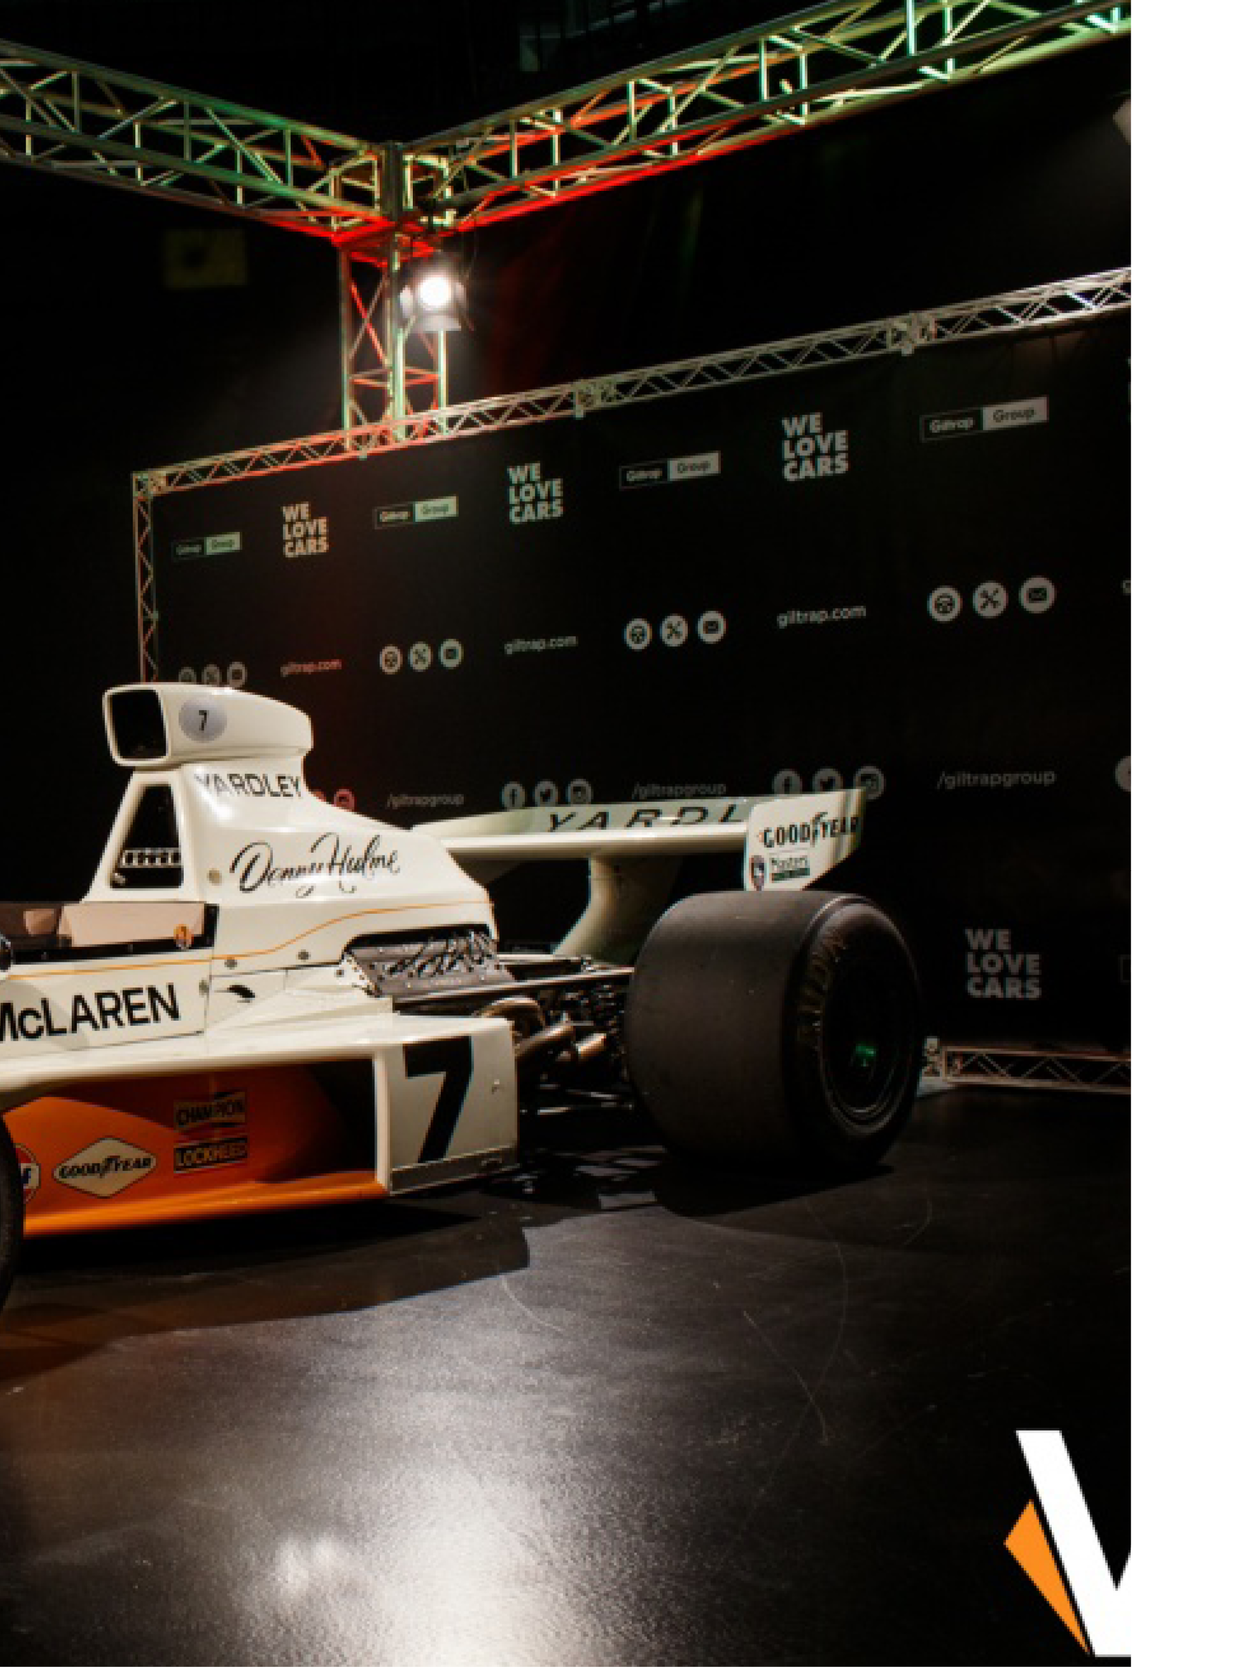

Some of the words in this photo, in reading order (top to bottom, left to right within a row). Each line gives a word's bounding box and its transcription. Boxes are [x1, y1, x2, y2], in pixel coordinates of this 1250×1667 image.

[781, 411, 823, 438] WE
[928, 417, 975, 434] Giltrap
[993, 408, 1035, 423] Group
[782, 430, 849, 460] LOVE
[507, 461, 541, 485] WE
[676, 459, 712, 474] Group
[783, 452, 850, 482] CARS
[508, 478, 564, 505] LOVE
[282, 503, 310, 522] WE
[510, 498, 565, 525] CARS
[282, 517, 328, 541] LOVE
[283, 536, 330, 558] CARS
[776, 605, 867, 630] giltrap.com
[504, 635, 579, 656] giltrap.com
[198, 709, 209, 731] 7
[193, 773, 302, 797] YARDLEY
[936, 770, 1058, 791] /giltrapgroup
[547, 803, 745, 833] YARDL
[761, 811, 860, 849] GOODYEAR
[964, 927, 1012, 951] WE
[965, 951, 1042, 976] LOVE
[966, 975, 1043, 1000] CARS
[401, 1036, 473, 1164] 7
[174, 1100, 245, 1127] CHAMPION
[57, 1154, 153, 1180] GOODYEAR
[175, 1143, 247, 1168] LOCKHEED
